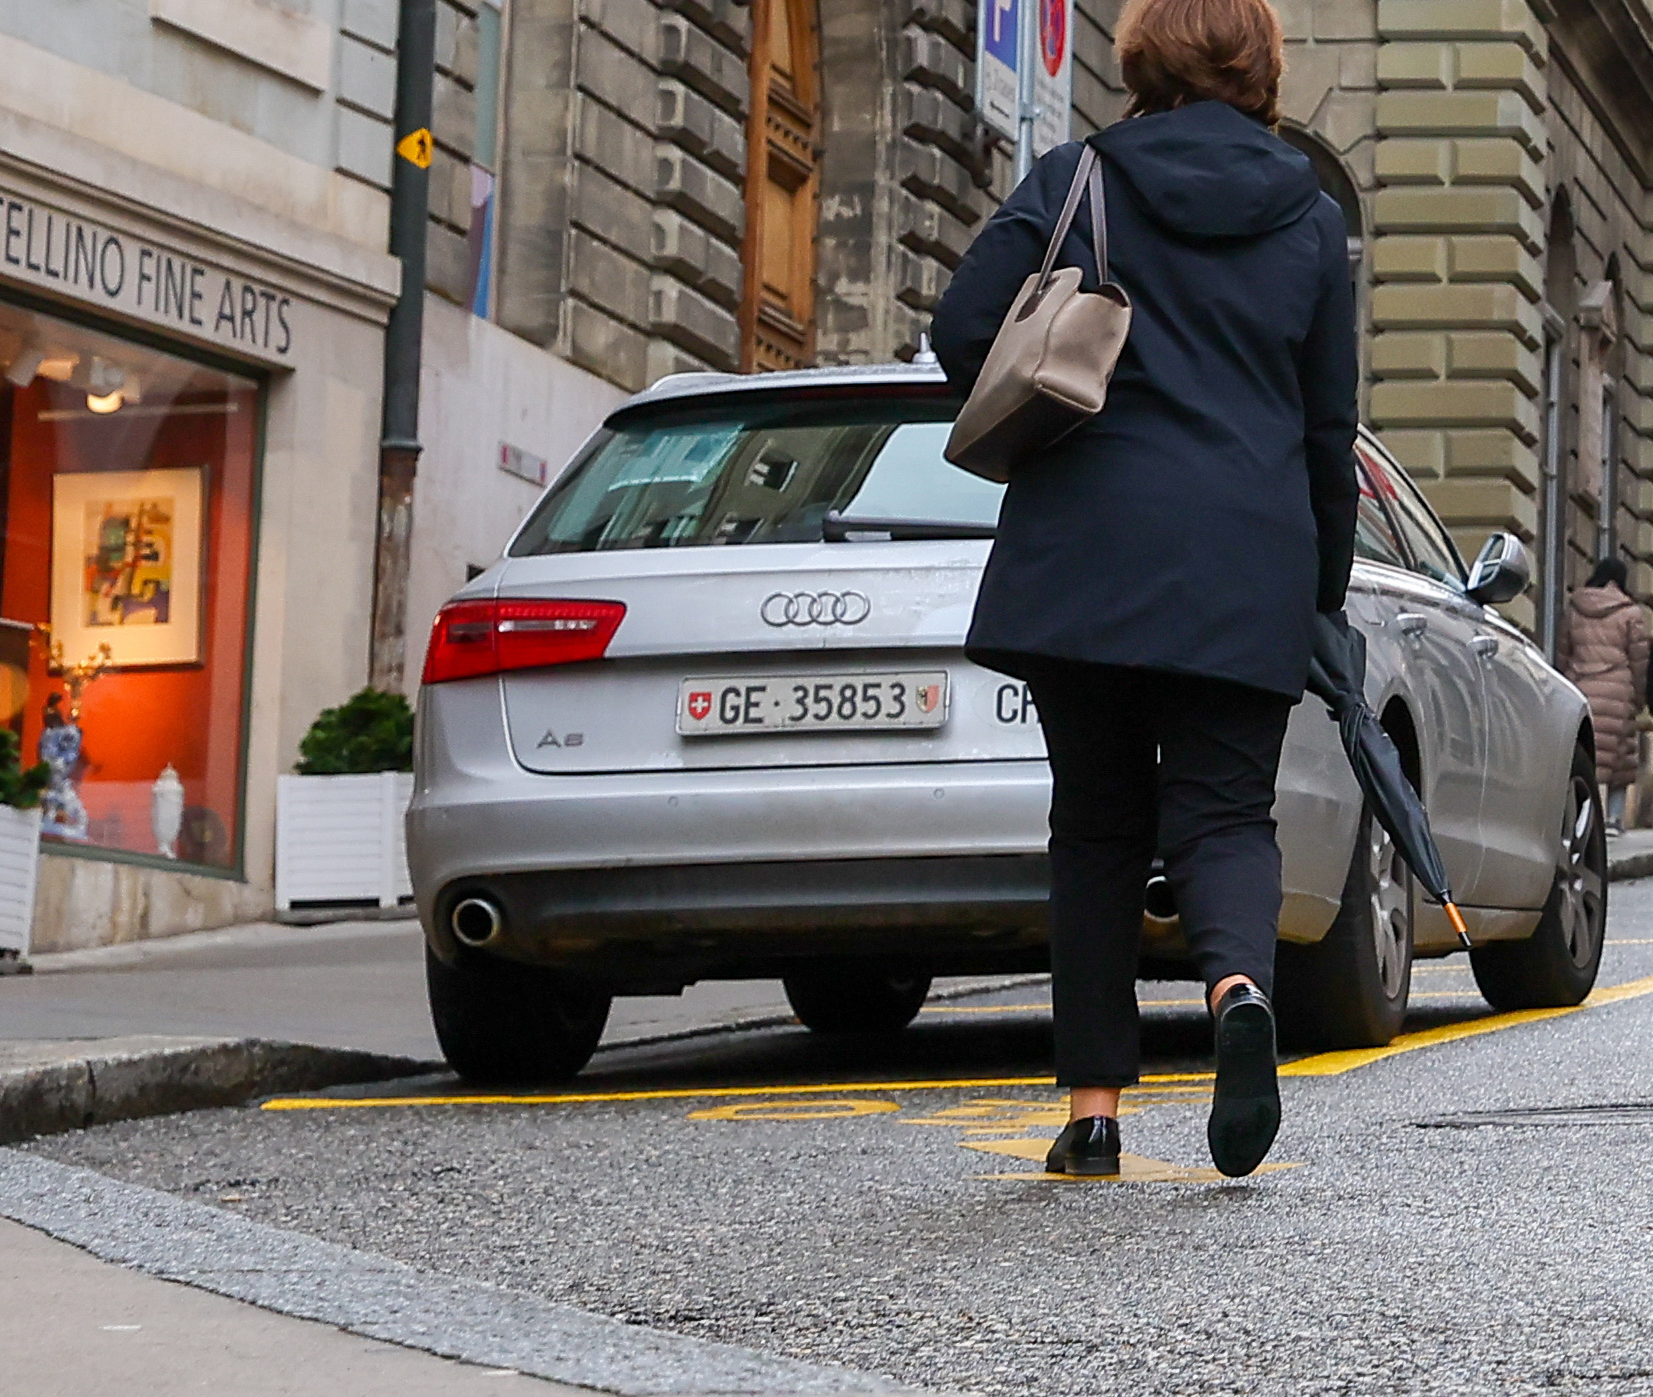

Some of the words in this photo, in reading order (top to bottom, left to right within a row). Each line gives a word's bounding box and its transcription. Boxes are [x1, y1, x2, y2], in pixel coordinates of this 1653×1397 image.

[0, 196, 125, 297] ELLINO
[137, 248, 205, 326] FINE
[214, 277, 291, 355] ARTS
